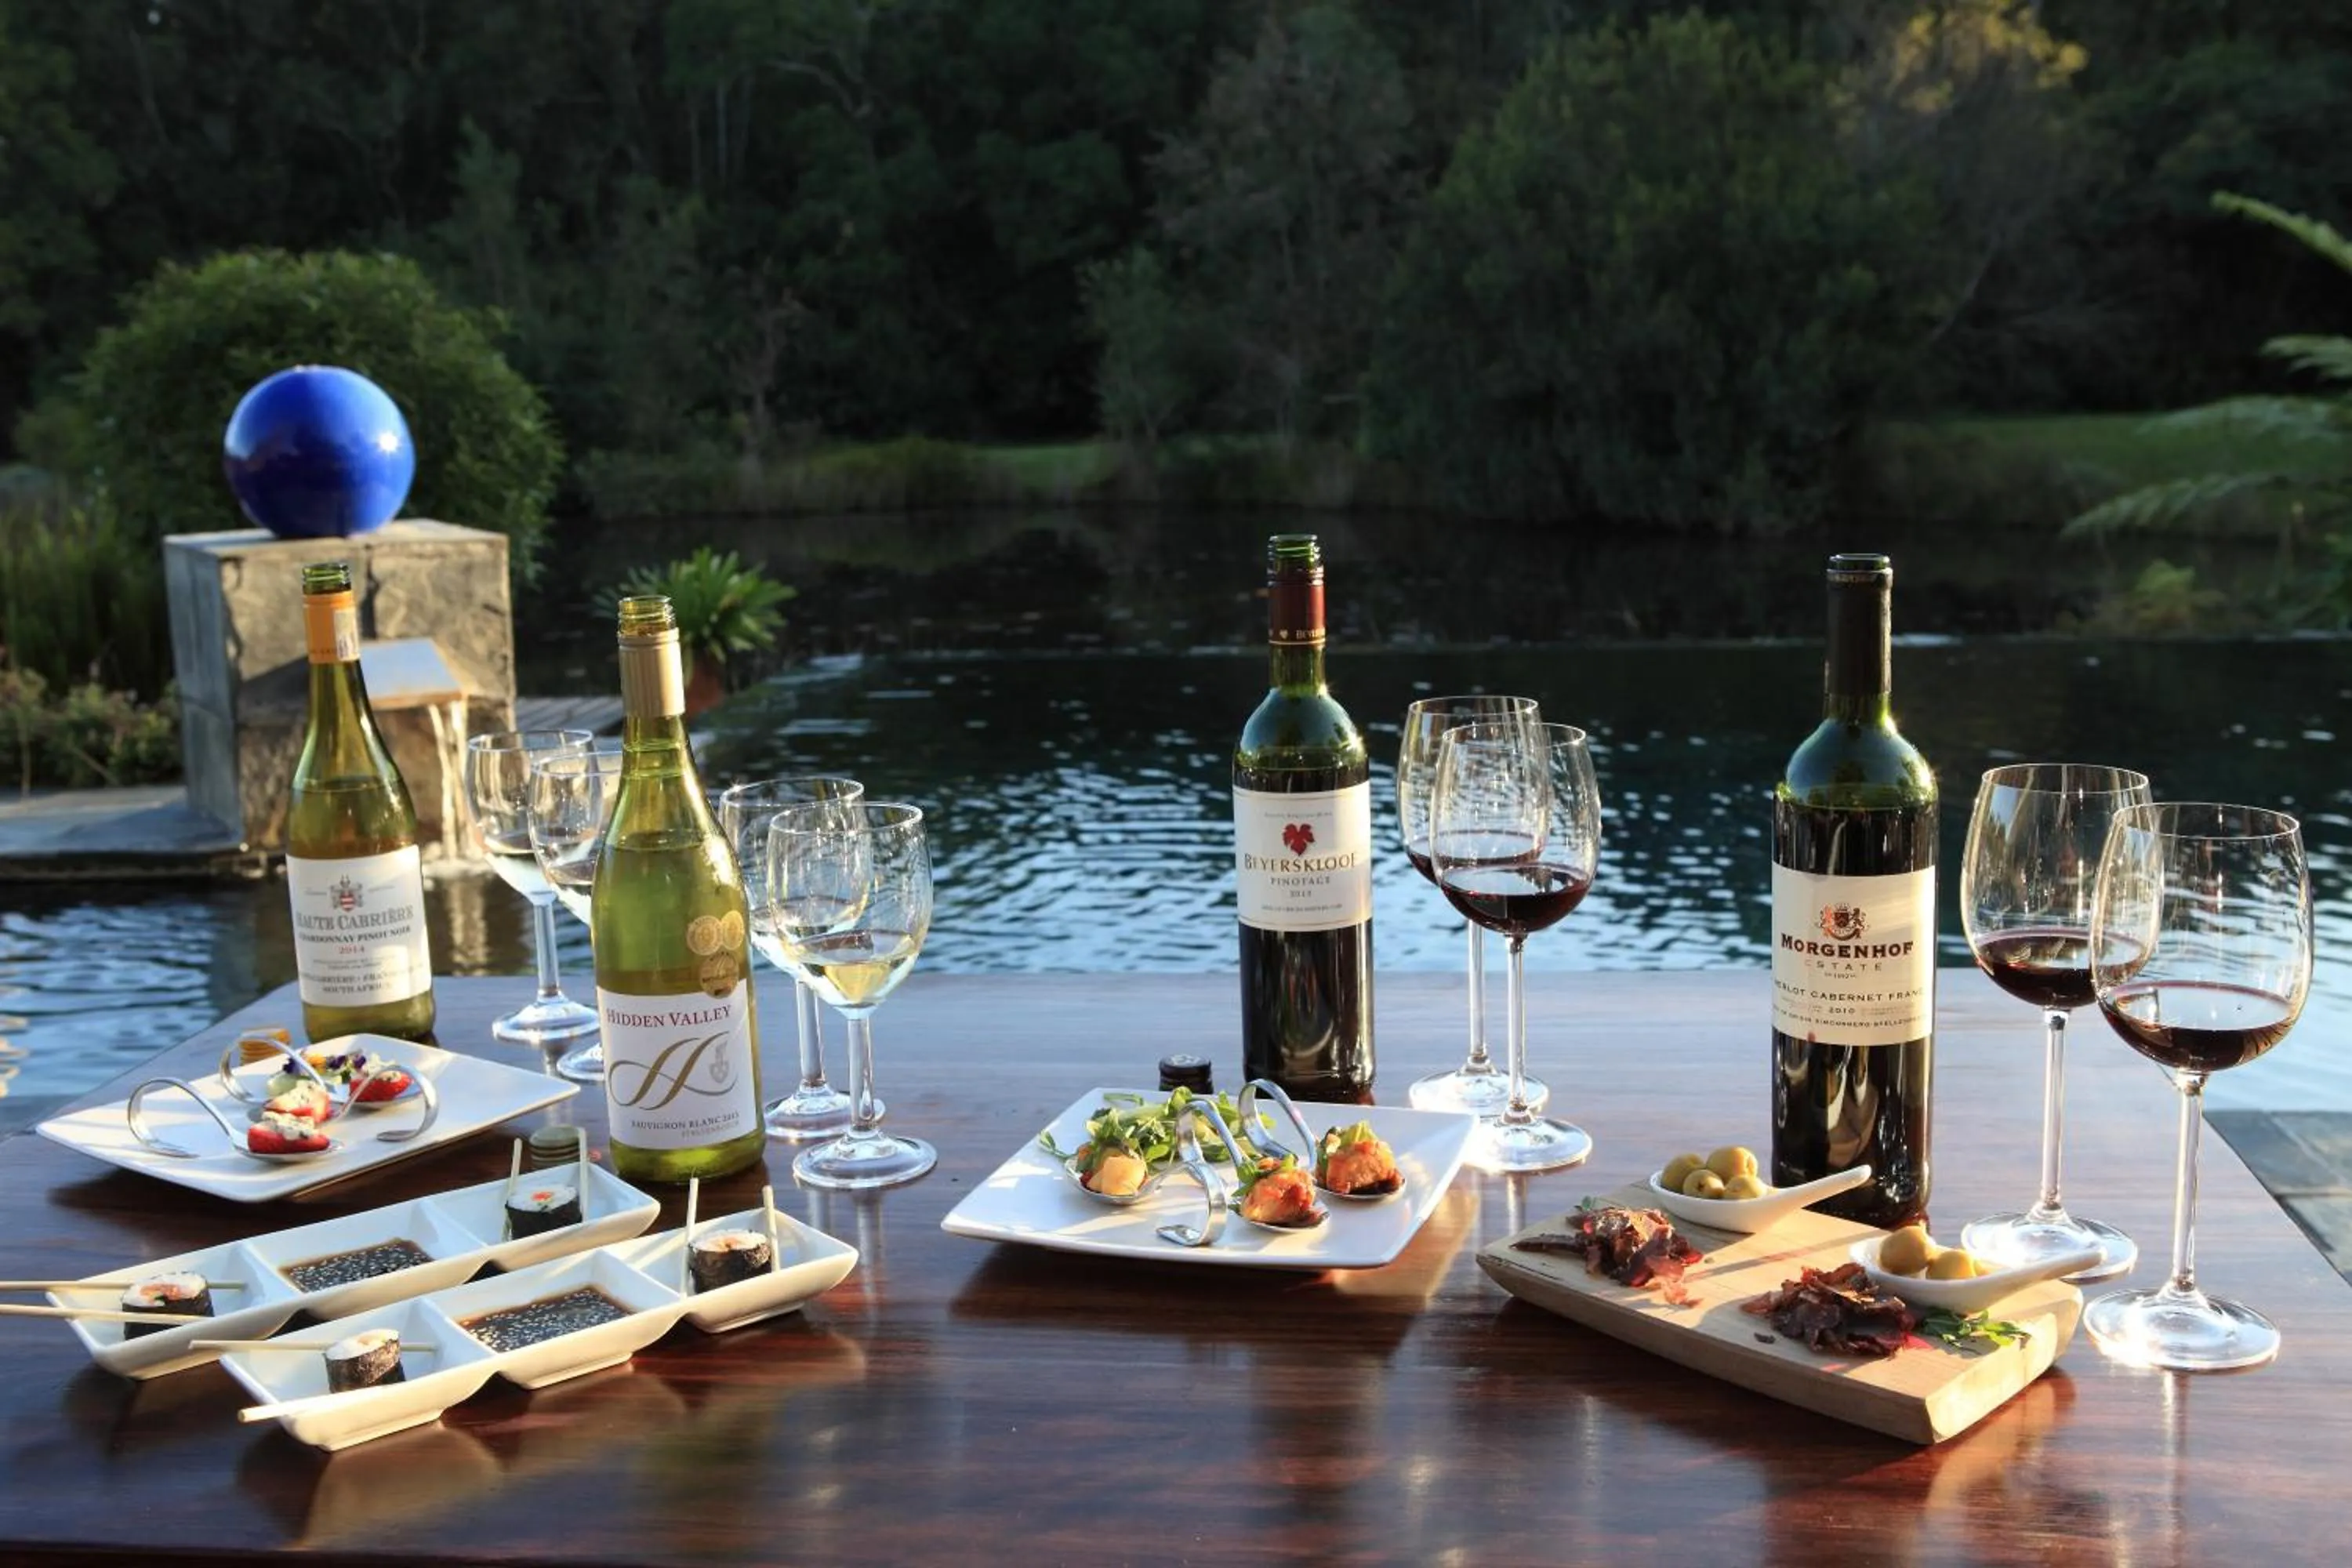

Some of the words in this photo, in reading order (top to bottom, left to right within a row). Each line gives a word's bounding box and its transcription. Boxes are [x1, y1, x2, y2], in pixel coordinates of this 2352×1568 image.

[1244, 852, 1356, 873] BEYERSKLOOF
[1271, 876, 1330, 885] PINOTAGE
[358, 931, 388, 942] PINOT
[389, 925, 411, 937] NOIR
[1780, 932, 1914, 959] MORGENHOF
[1804, 959, 1882, 972] ESTATE
[1810, 989, 1882, 1001] CABERNET
[606, 1007, 665, 1028] HIDDEN
[668, 1004, 731, 1028] VALLEY
[631, 1119, 686, 1130] SAUVIGNON
[689, 1115, 721, 1128] BLANC
